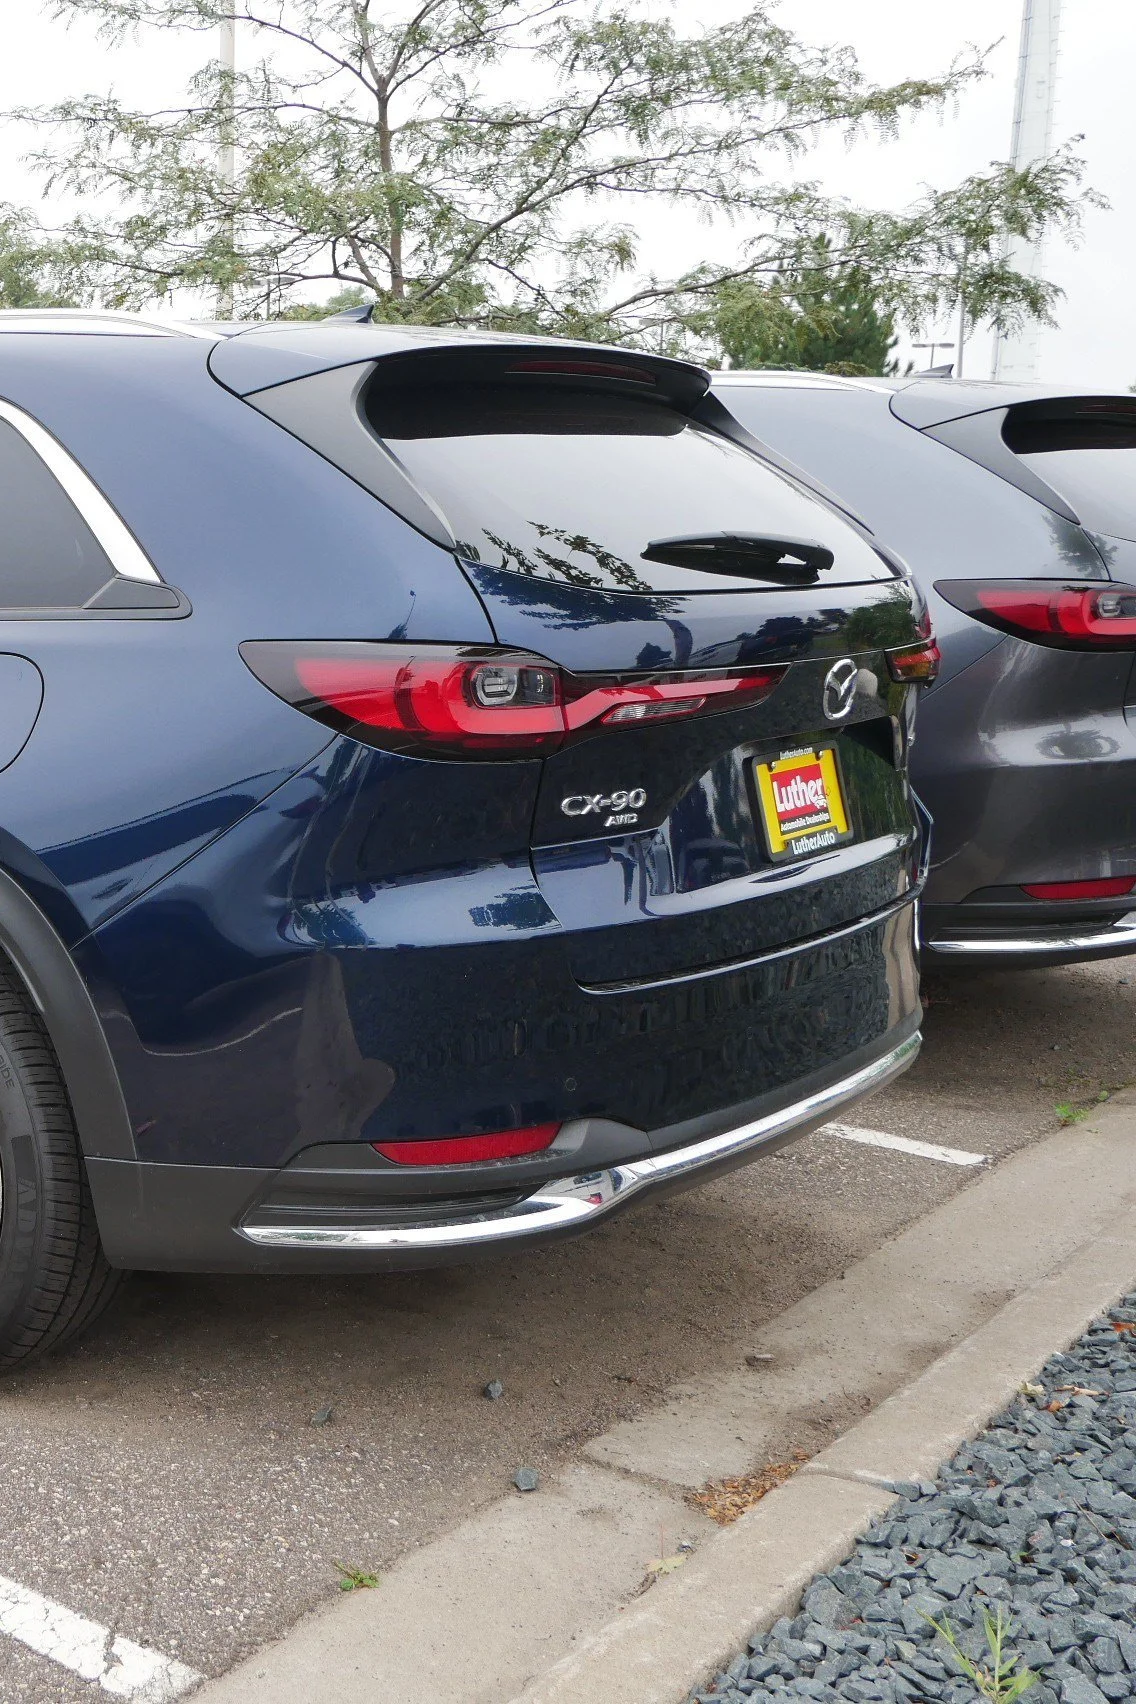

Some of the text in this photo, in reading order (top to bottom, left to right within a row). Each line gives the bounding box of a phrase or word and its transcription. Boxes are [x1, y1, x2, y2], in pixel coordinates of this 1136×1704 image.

[561, 788, 647, 816] CX-90
[772, 775, 824, 813] Luther
[604, 813, 638, 827] AWD
[781, 812, 830, 832] Automobile Dealerships
[791, 831, 835, 855] LutherAuto
